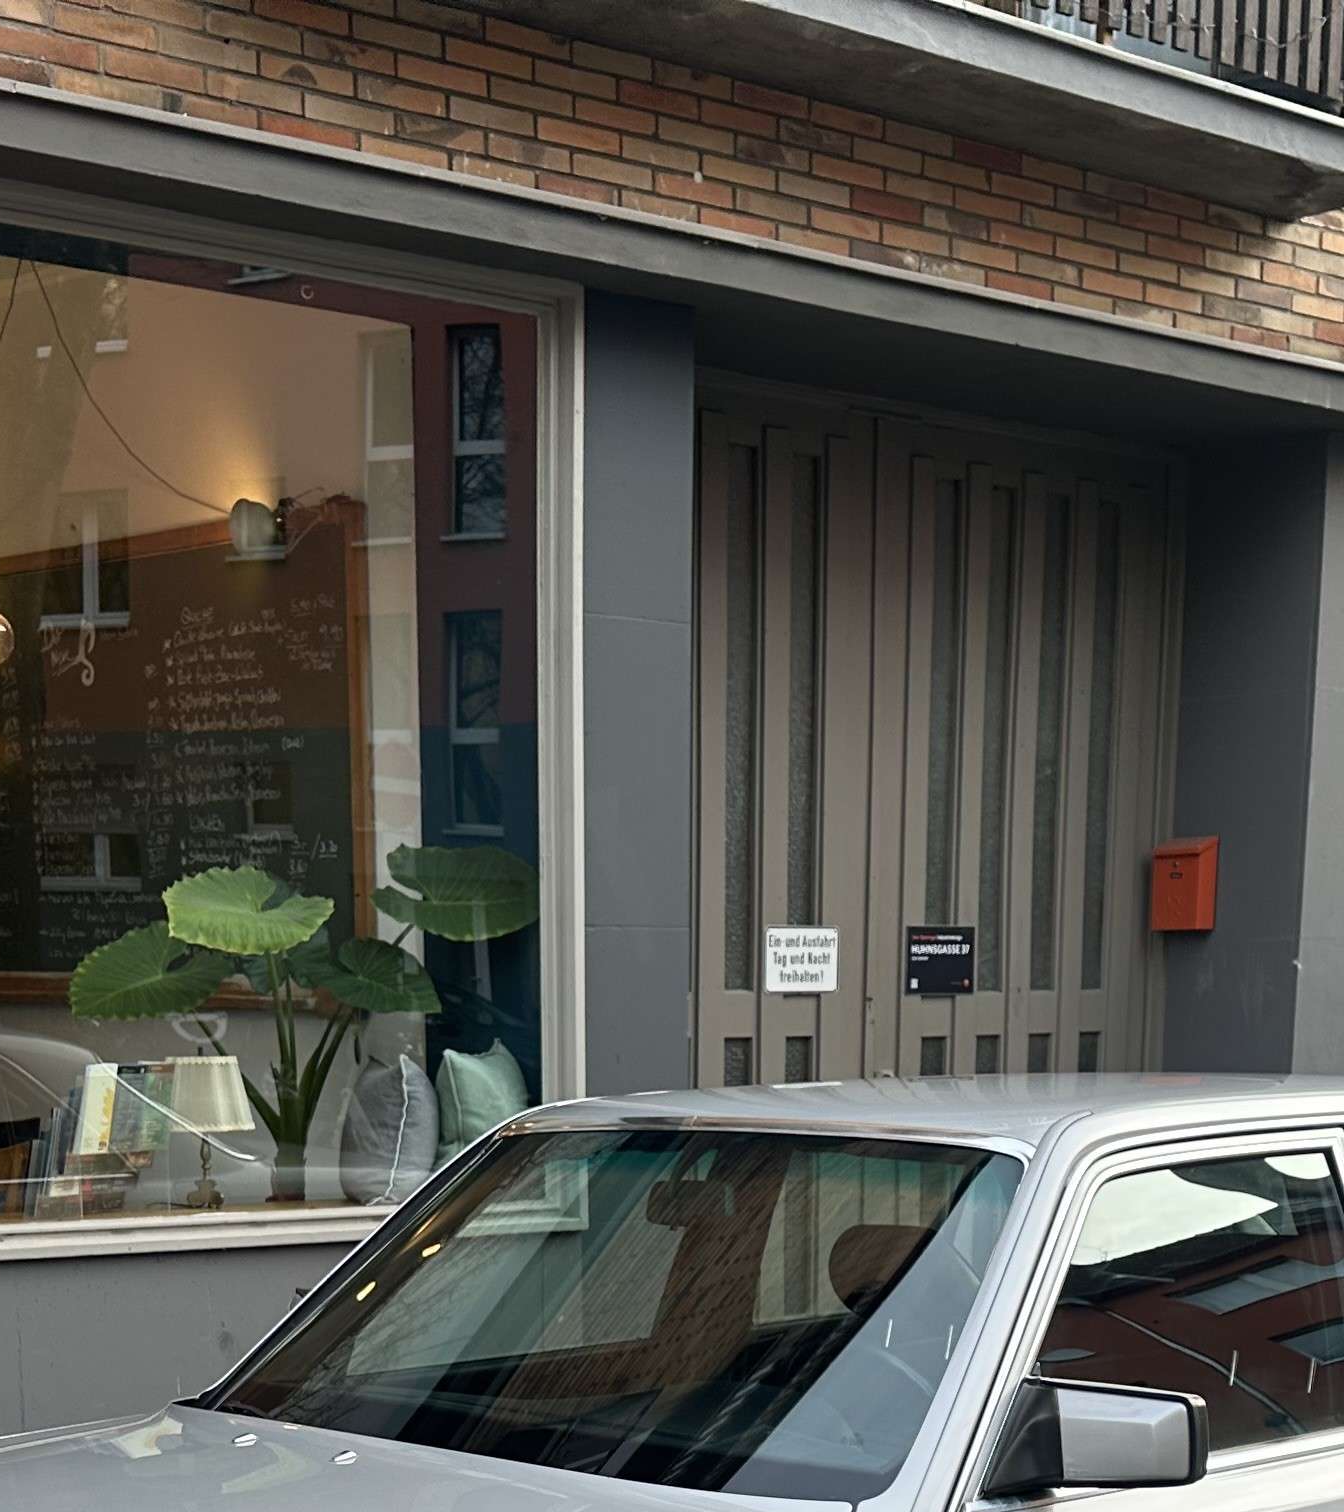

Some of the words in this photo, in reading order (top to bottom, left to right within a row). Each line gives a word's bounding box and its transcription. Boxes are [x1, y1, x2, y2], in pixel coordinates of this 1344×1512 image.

[786, 934, 800, 948] und
[802, 934, 836, 948] Ausfahrt
[773, 951, 786, 967] Tag
[790, 951, 804, 965] und
[808, 951, 830, 965] Nacht
